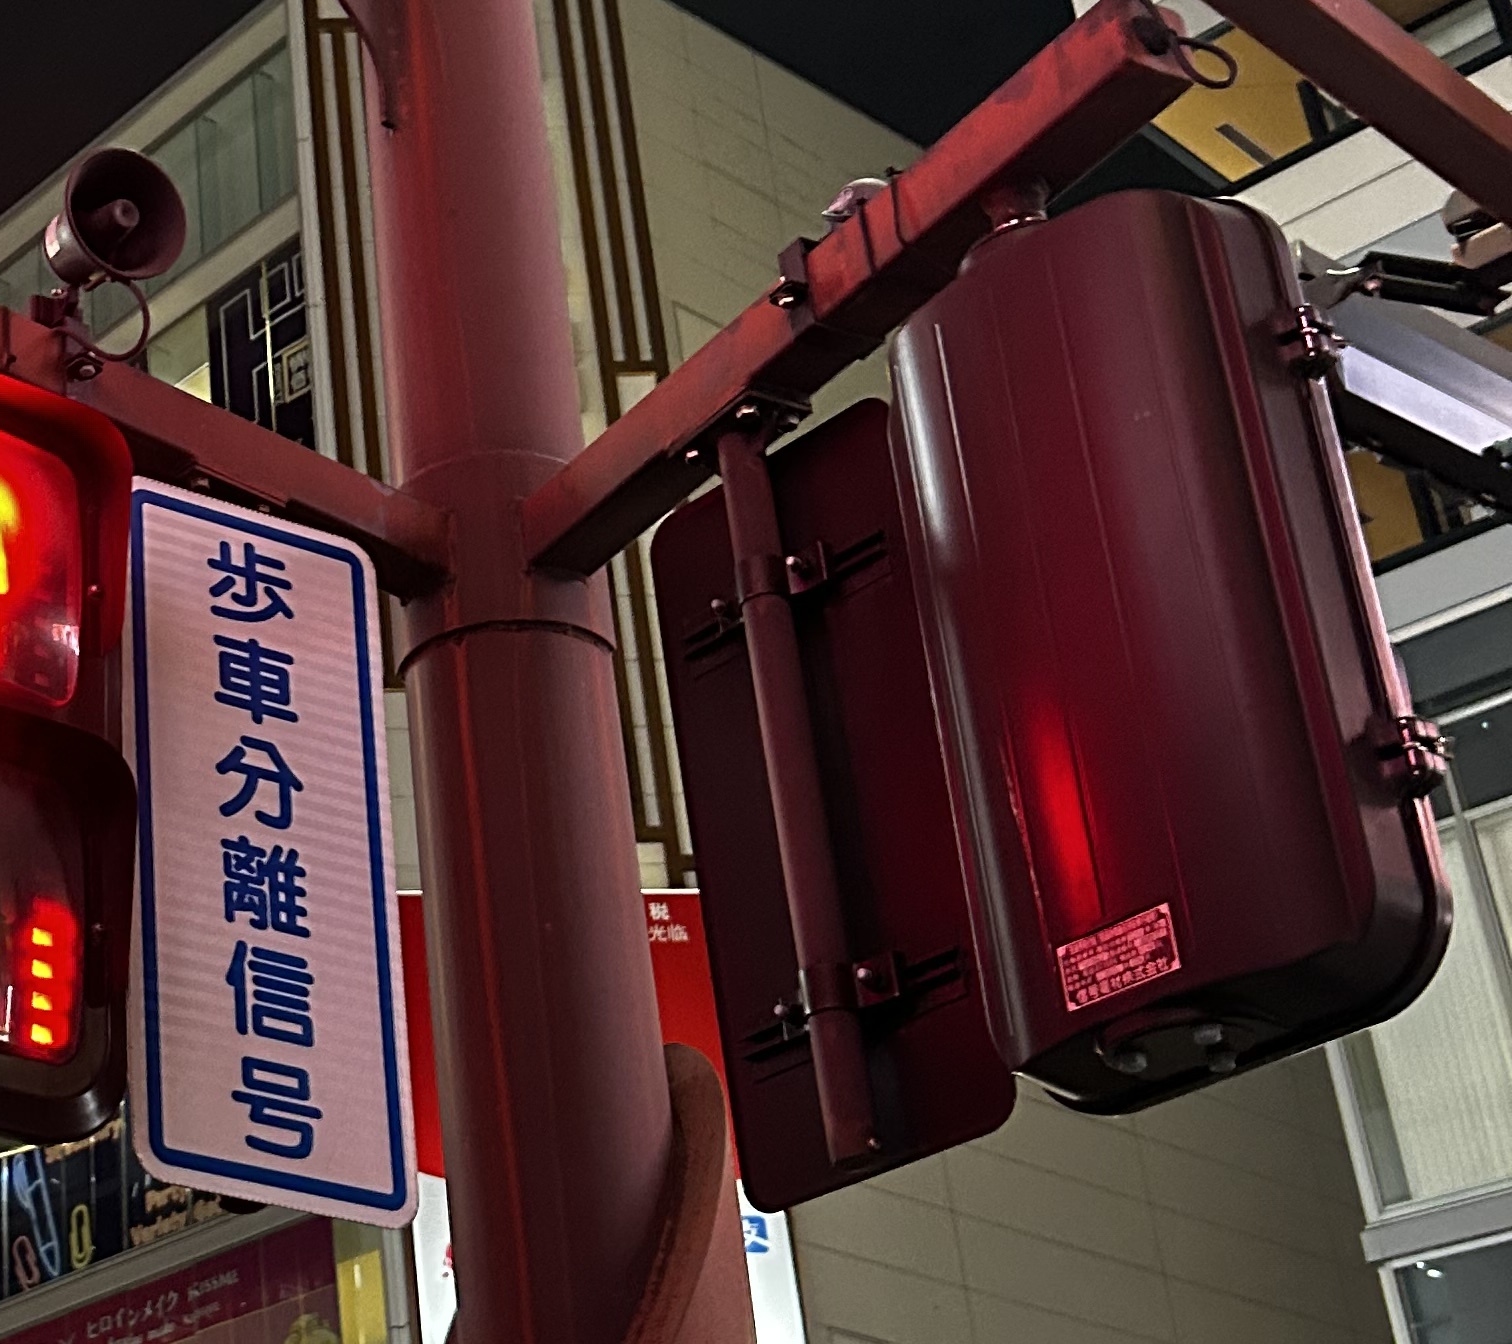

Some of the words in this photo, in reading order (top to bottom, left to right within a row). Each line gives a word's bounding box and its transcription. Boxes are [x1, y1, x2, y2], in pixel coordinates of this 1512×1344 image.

[208, 541, 322, 1161] 歩車分離信号
